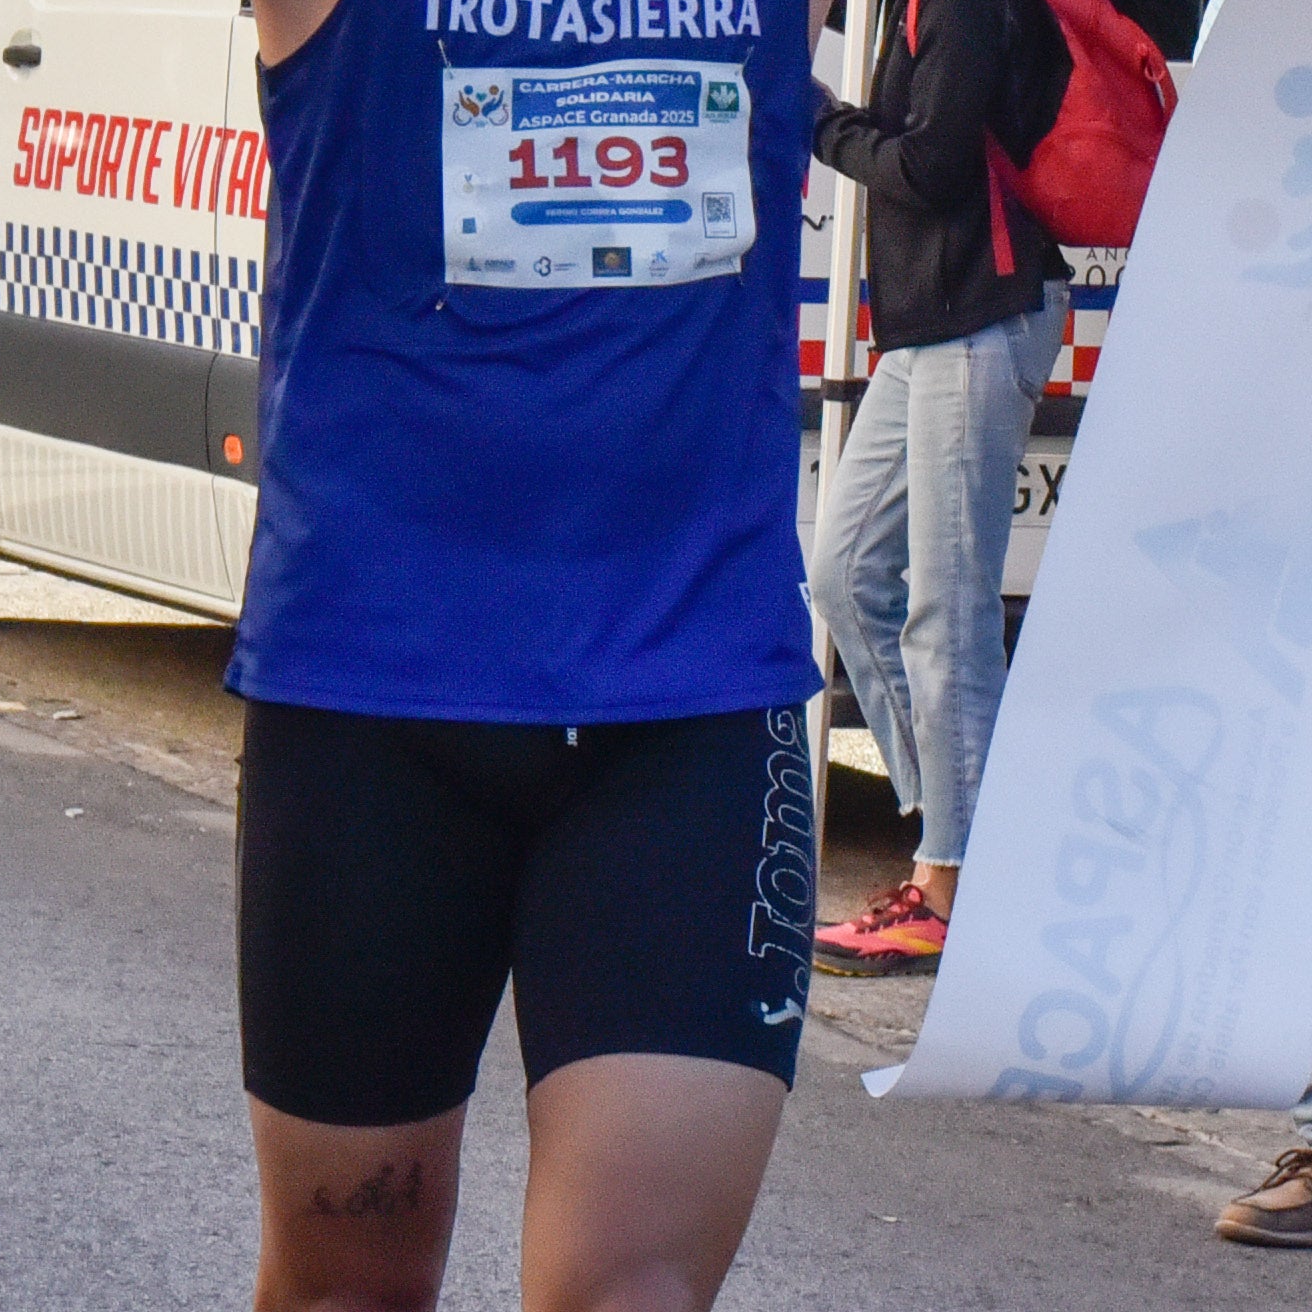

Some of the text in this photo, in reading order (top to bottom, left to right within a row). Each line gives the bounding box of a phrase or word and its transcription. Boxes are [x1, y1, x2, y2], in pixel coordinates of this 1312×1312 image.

[519, 73, 696, 94] CARRERA-MARCHA
[556, 91, 656, 108] SOLIDARIA
[519, 110, 587, 129] ASPACE
[590, 110, 658, 125] Granada
[661, 110, 695, 124] 2025
[13, 106, 172, 205] SOPORTE
[508, 135, 690, 190] 1193
